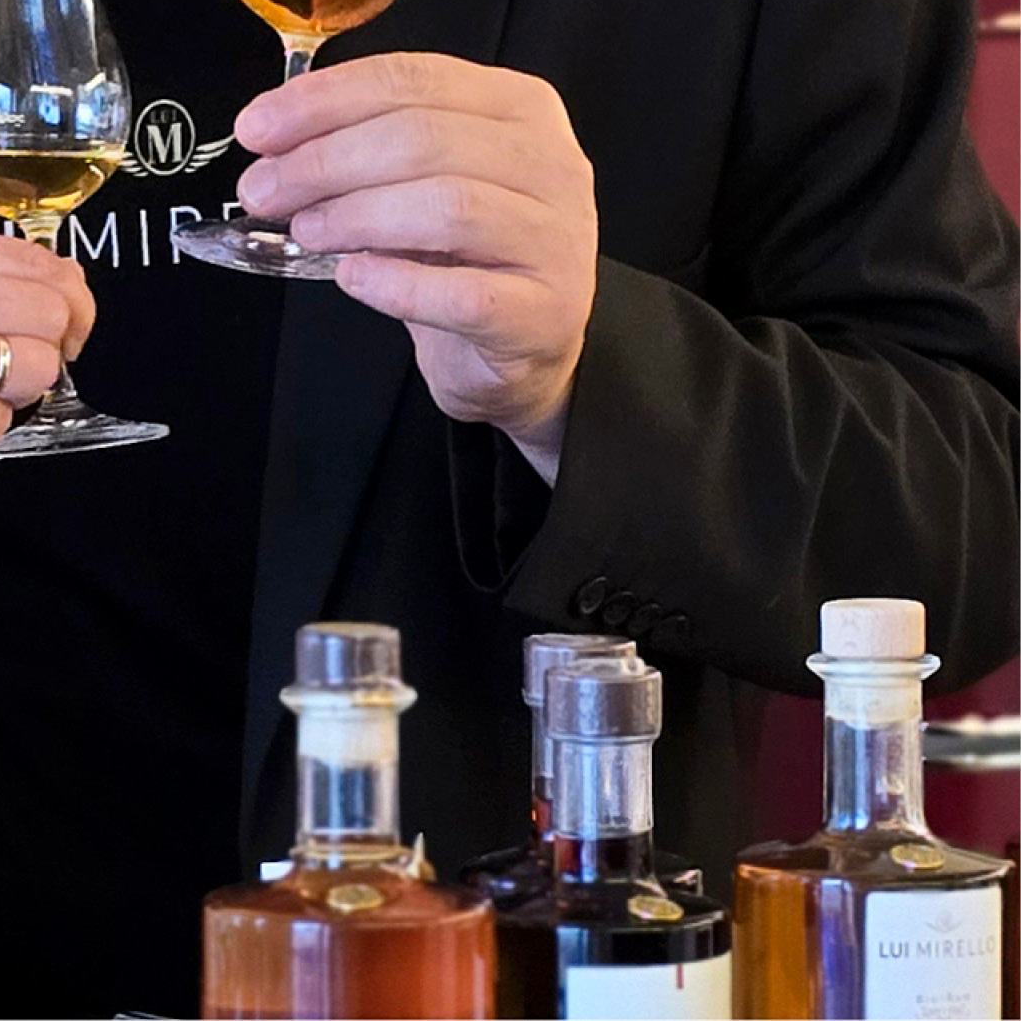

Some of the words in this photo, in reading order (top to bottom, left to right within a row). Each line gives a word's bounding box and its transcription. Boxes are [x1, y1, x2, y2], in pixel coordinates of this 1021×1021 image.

[146, 122, 183, 164] M
[878, 941, 909, 959] LUI
[915, 936, 997, 959] MIRELLO
